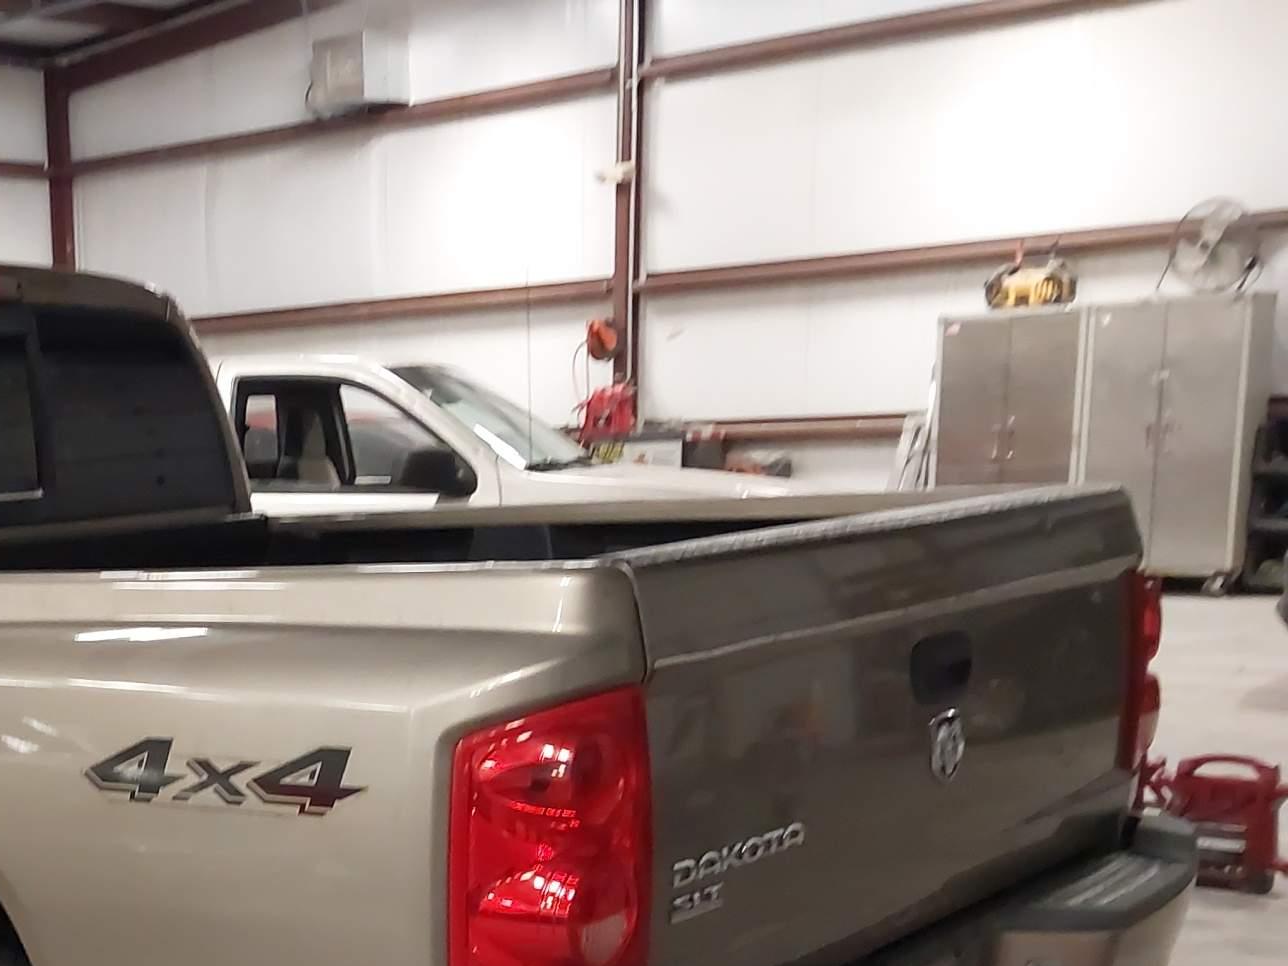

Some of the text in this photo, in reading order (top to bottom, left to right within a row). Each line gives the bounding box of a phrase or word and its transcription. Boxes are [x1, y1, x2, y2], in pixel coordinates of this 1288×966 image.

[83, 736, 369, 816] 4x4
[672, 821, 806, 889] DAKOTA
[671, 881, 725, 922] SLT
